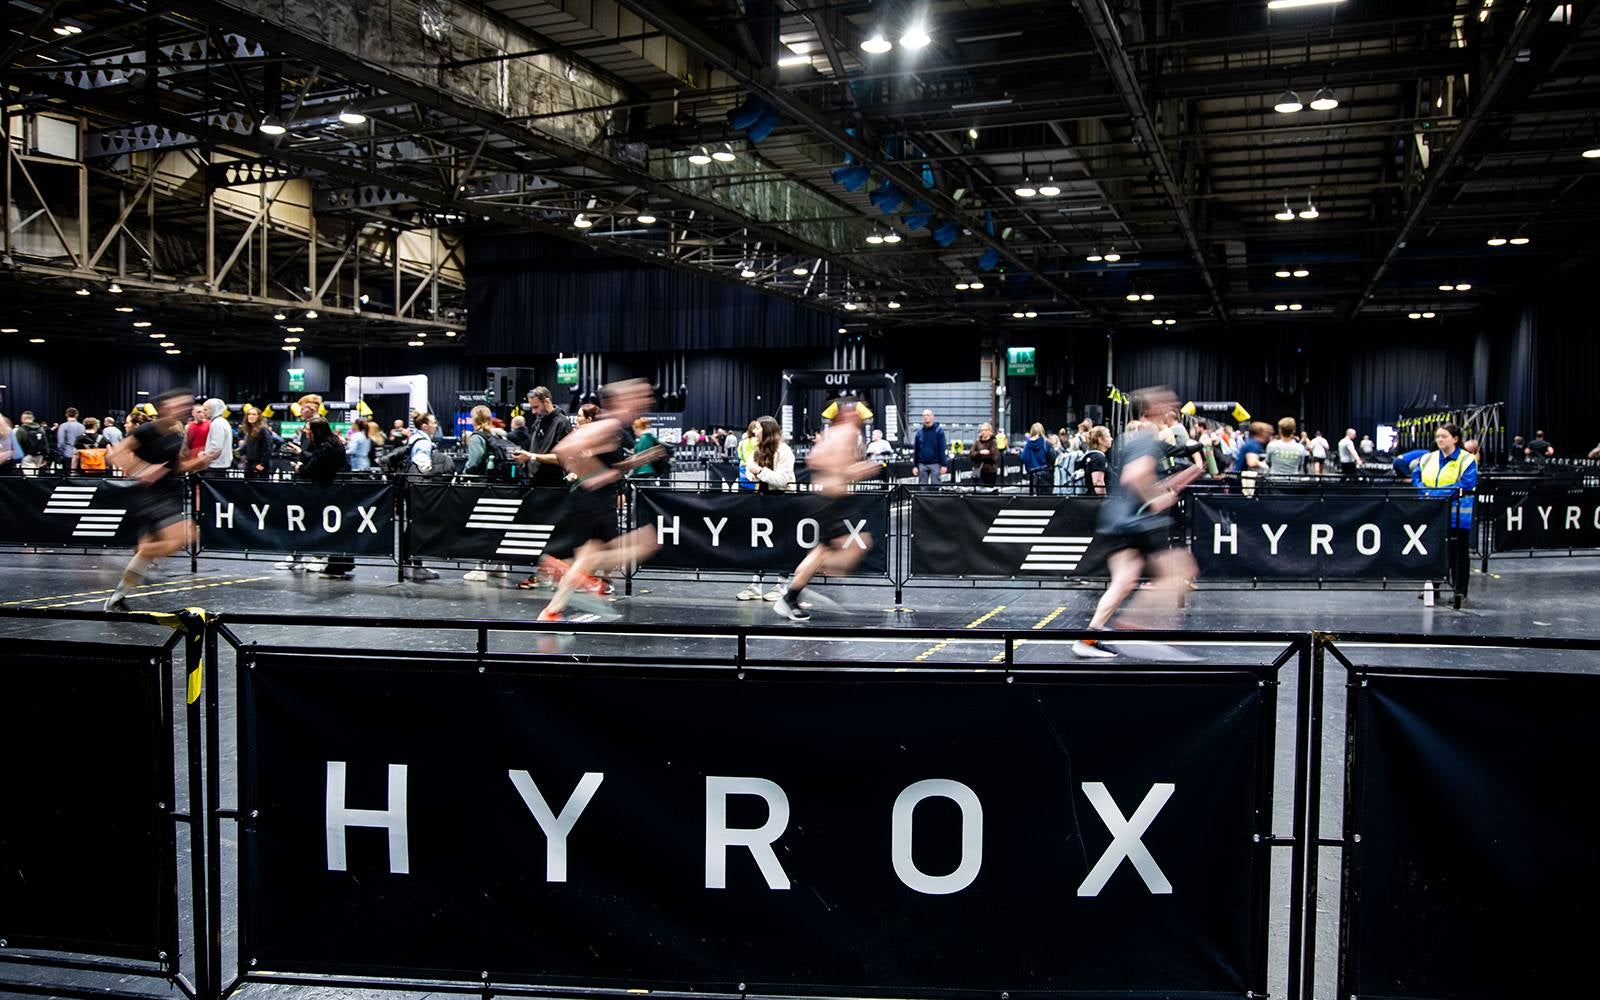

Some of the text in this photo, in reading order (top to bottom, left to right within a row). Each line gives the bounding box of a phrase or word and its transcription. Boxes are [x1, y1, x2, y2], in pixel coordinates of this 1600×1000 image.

[825, 374, 850, 385] OUT
[215, 502, 378, 534] HYROX
[656, 515, 867, 550] HYROX
[1213, 523, 1428, 556] HYROX
[325, 760, 1176, 897] HYROX
